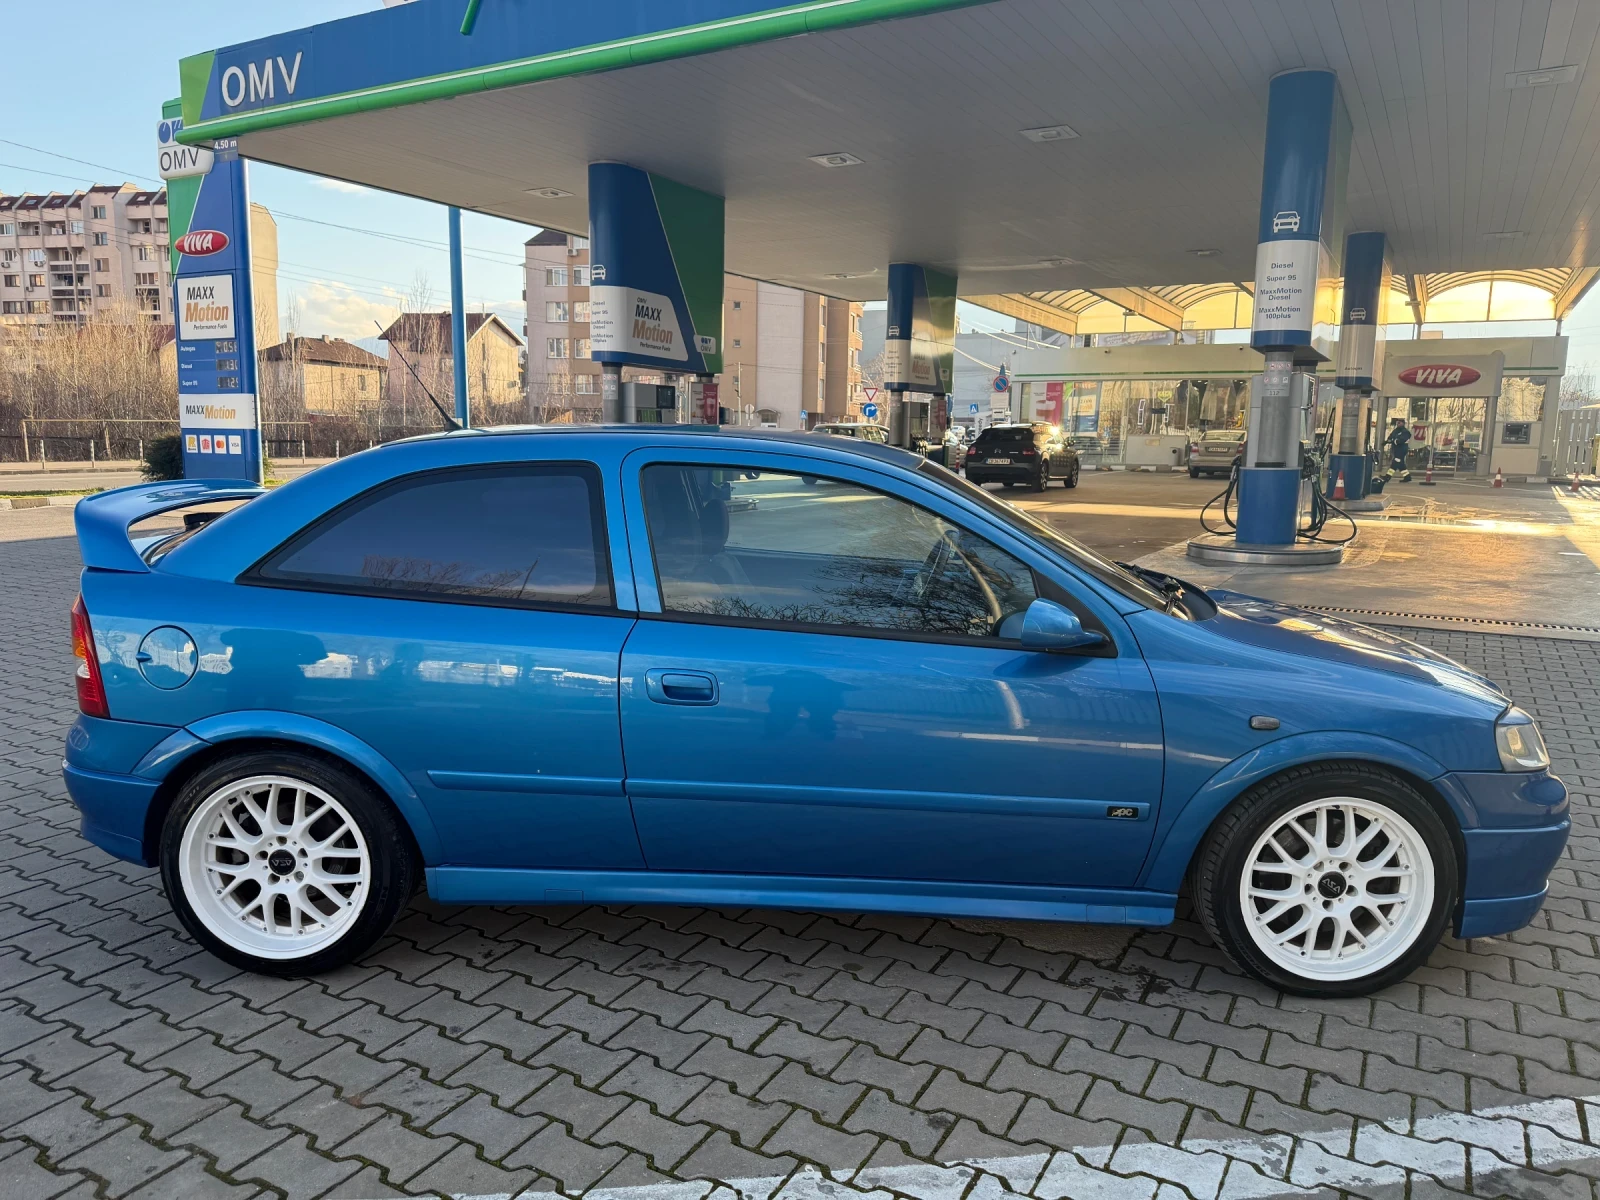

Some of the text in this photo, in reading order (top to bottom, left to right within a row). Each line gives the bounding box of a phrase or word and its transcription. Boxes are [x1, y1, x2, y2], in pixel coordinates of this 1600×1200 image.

[222, 51, 303, 107] OMV
[214, 140, 237, 150] 4.50 m
[160, 148, 199, 172] OMV
[183, 233, 213, 252] VIVA
[1266, 275, 1286, 283] Super
[187, 286, 215, 301] MAXX
[1260, 287, 1303, 295] MaxxMotion
[185, 301, 229, 323] Motion
[635, 304, 662, 321] MAXX
[1258, 306, 1301, 314] MaxxMotion
[1265, 312, 1292, 320] 100plus
[632, 319, 673, 344] Motion
[639, 342, 661, 351] Performance
[1415, 367, 1463, 385] VIVA
